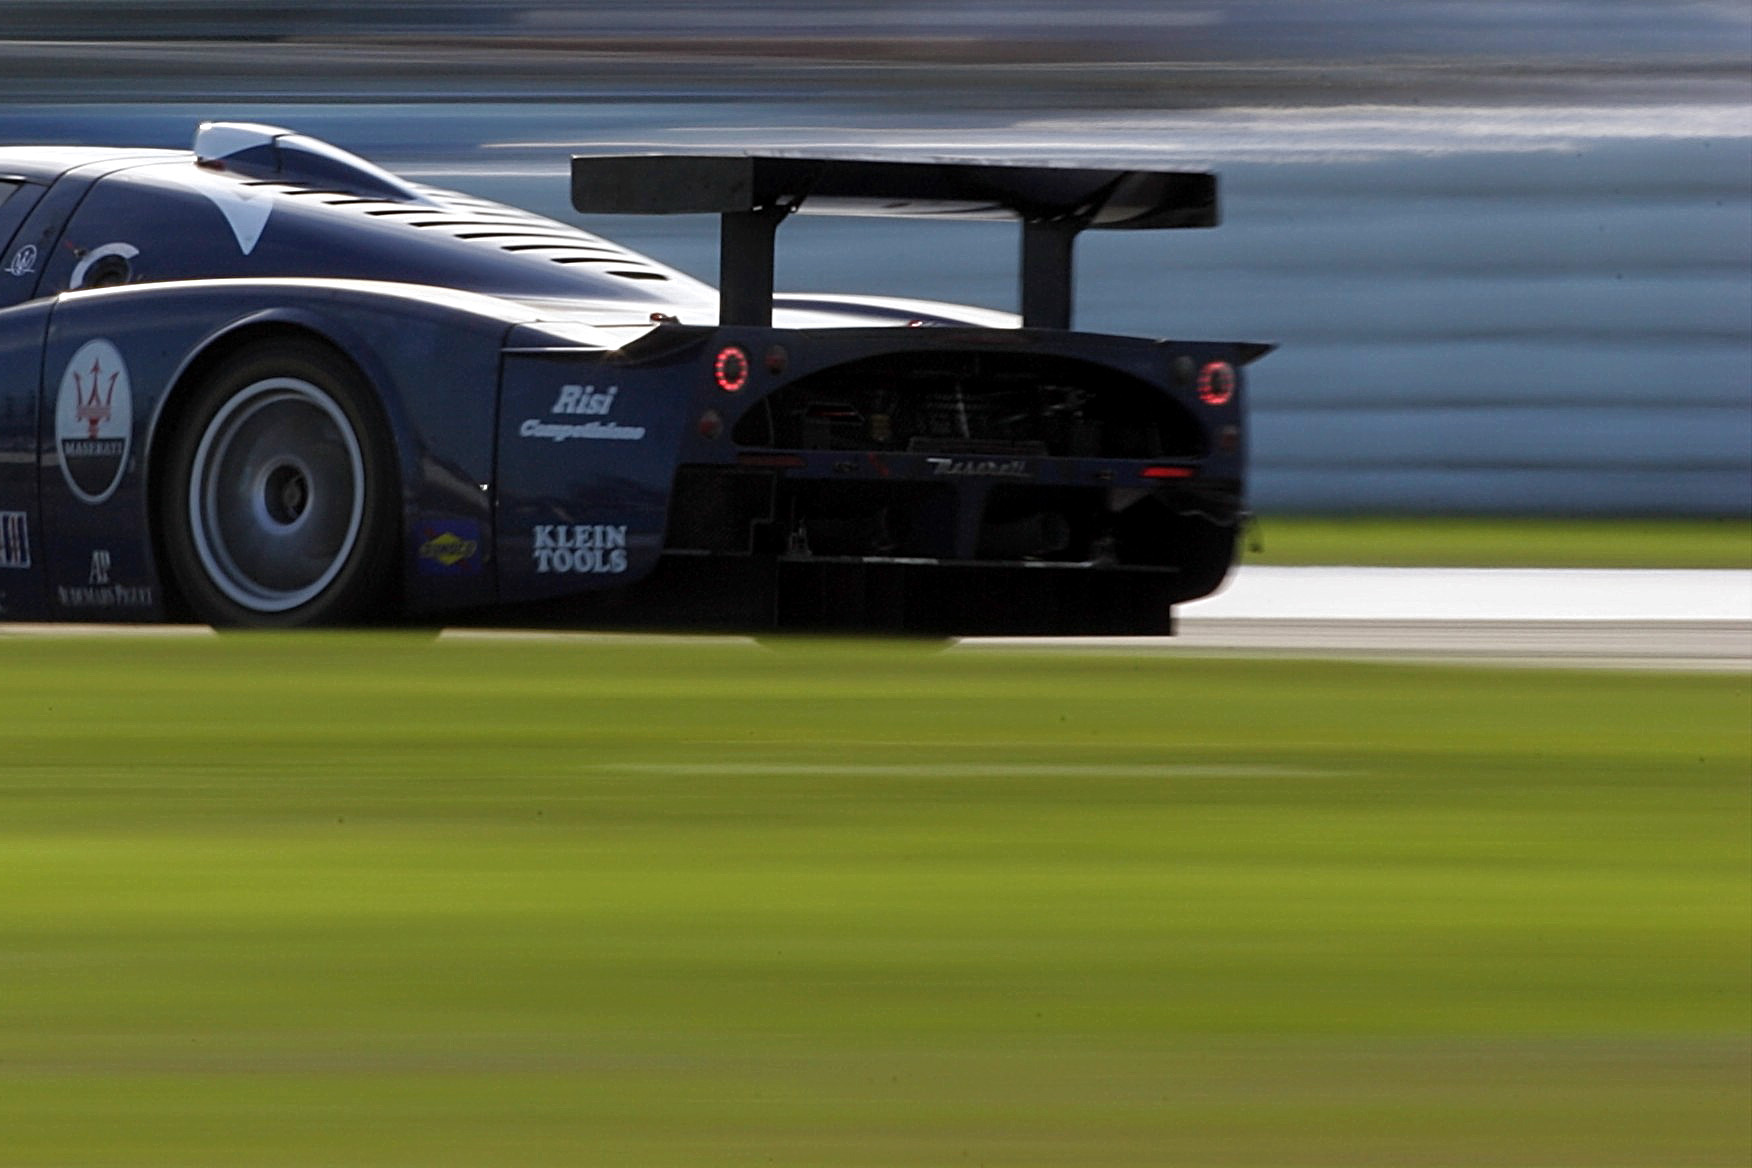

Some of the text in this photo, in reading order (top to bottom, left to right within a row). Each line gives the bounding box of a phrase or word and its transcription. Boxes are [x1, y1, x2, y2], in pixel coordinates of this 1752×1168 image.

[552, 384, 617, 414] Risi
[64, 440, 123, 456] MASERATI
[535, 524, 627, 548] KLEIN
[534, 548, 628, 573] TOOLS
